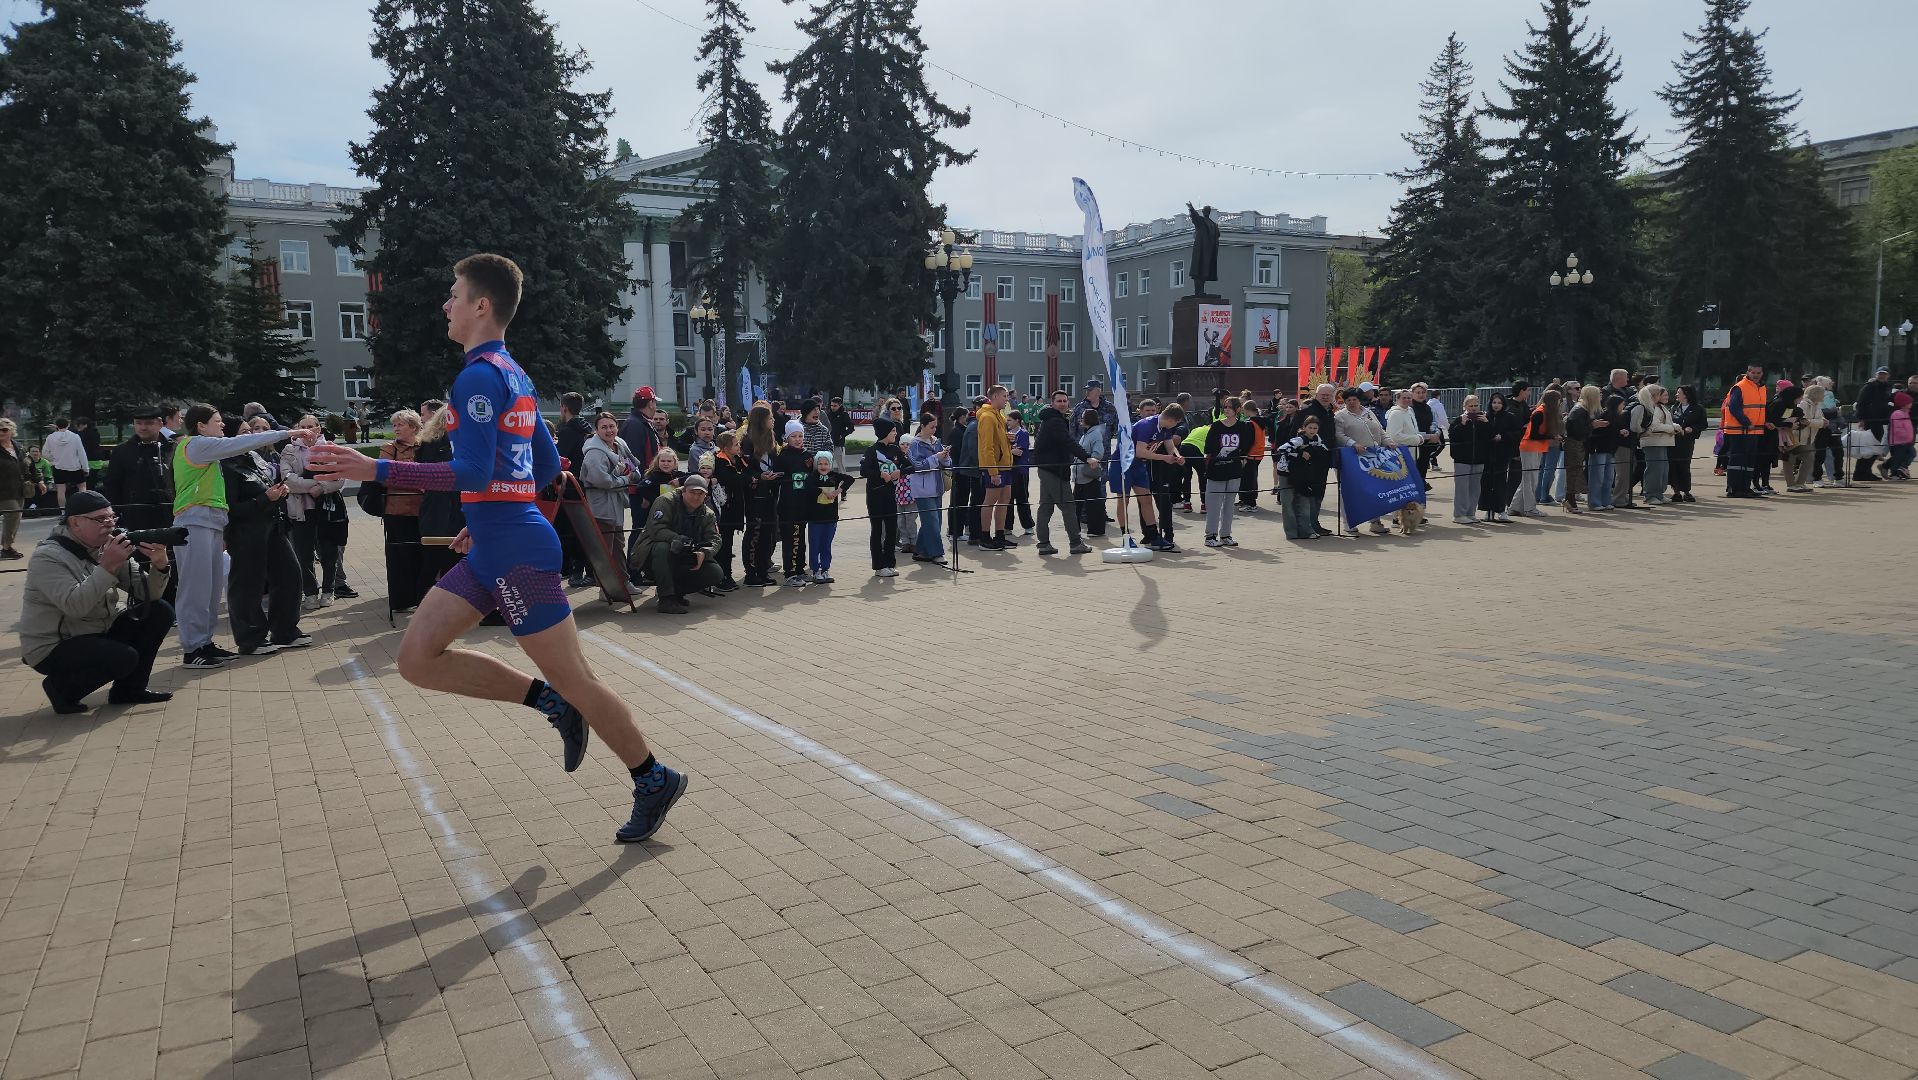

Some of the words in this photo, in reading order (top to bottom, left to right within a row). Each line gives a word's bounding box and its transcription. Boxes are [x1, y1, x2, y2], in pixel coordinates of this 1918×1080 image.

[852, 411, 873, 420] ПОБЕД
[1221, 433, 1240, 447] 09
[495, 577, 523, 625] STUPINO
